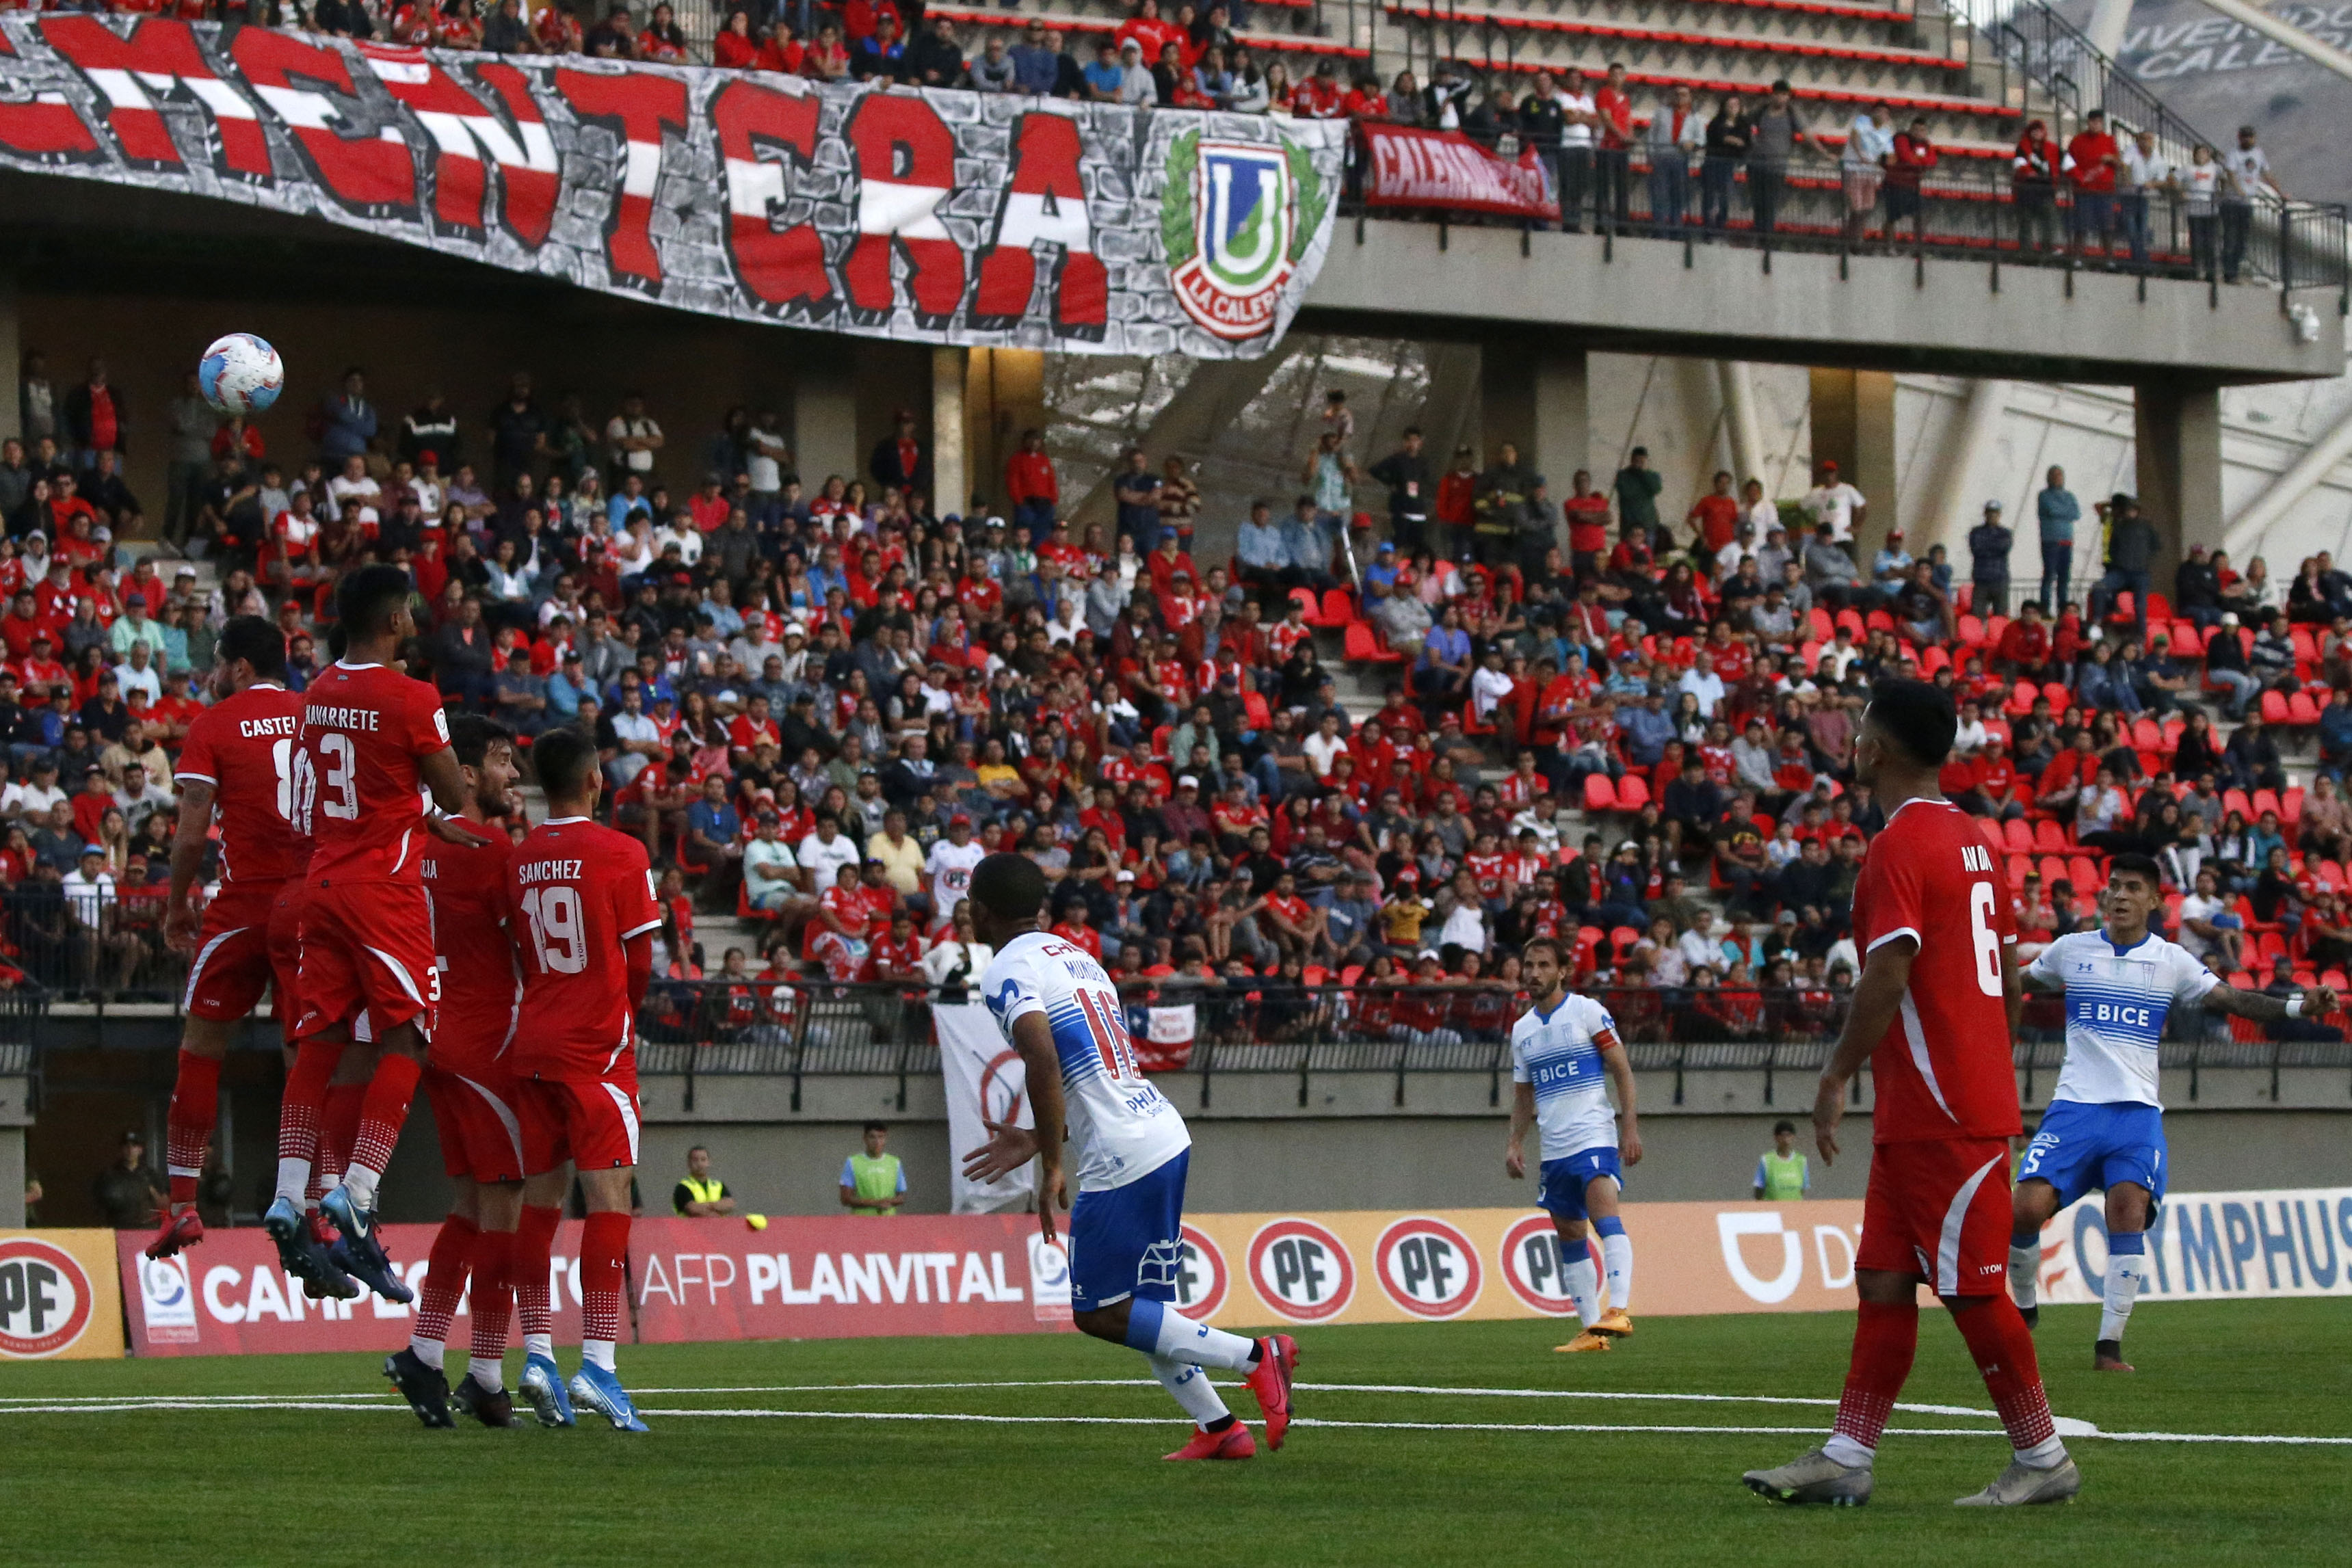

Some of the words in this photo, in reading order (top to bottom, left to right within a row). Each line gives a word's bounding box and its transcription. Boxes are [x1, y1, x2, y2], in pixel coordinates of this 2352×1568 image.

[1188, 276, 1213, 310] LA
[1213, 281, 1284, 322] CALER
[319, 733, 358, 821] 3
[519, 860, 582, 885] SANCHEZ
[520, 886, 588, 974] 19
[1970, 881, 2003, 997] 6
[427, 966, 442, 1002] 3
[2097, 1003, 2150, 1027] BICE
[1540, 1061, 1579, 1084] BICE
[2024, 1148, 2046, 1174] 5
[640, 1253, 736, 1305] AFP
[746, 1251, 1025, 1305] PLANVITAL
[1272, 1239, 1325, 1302] PF
[1399, 1237, 1452, 1299] PF
[1980, 1264, 2003, 1276] LYON
[0, 1261, 57, 1334] PF
